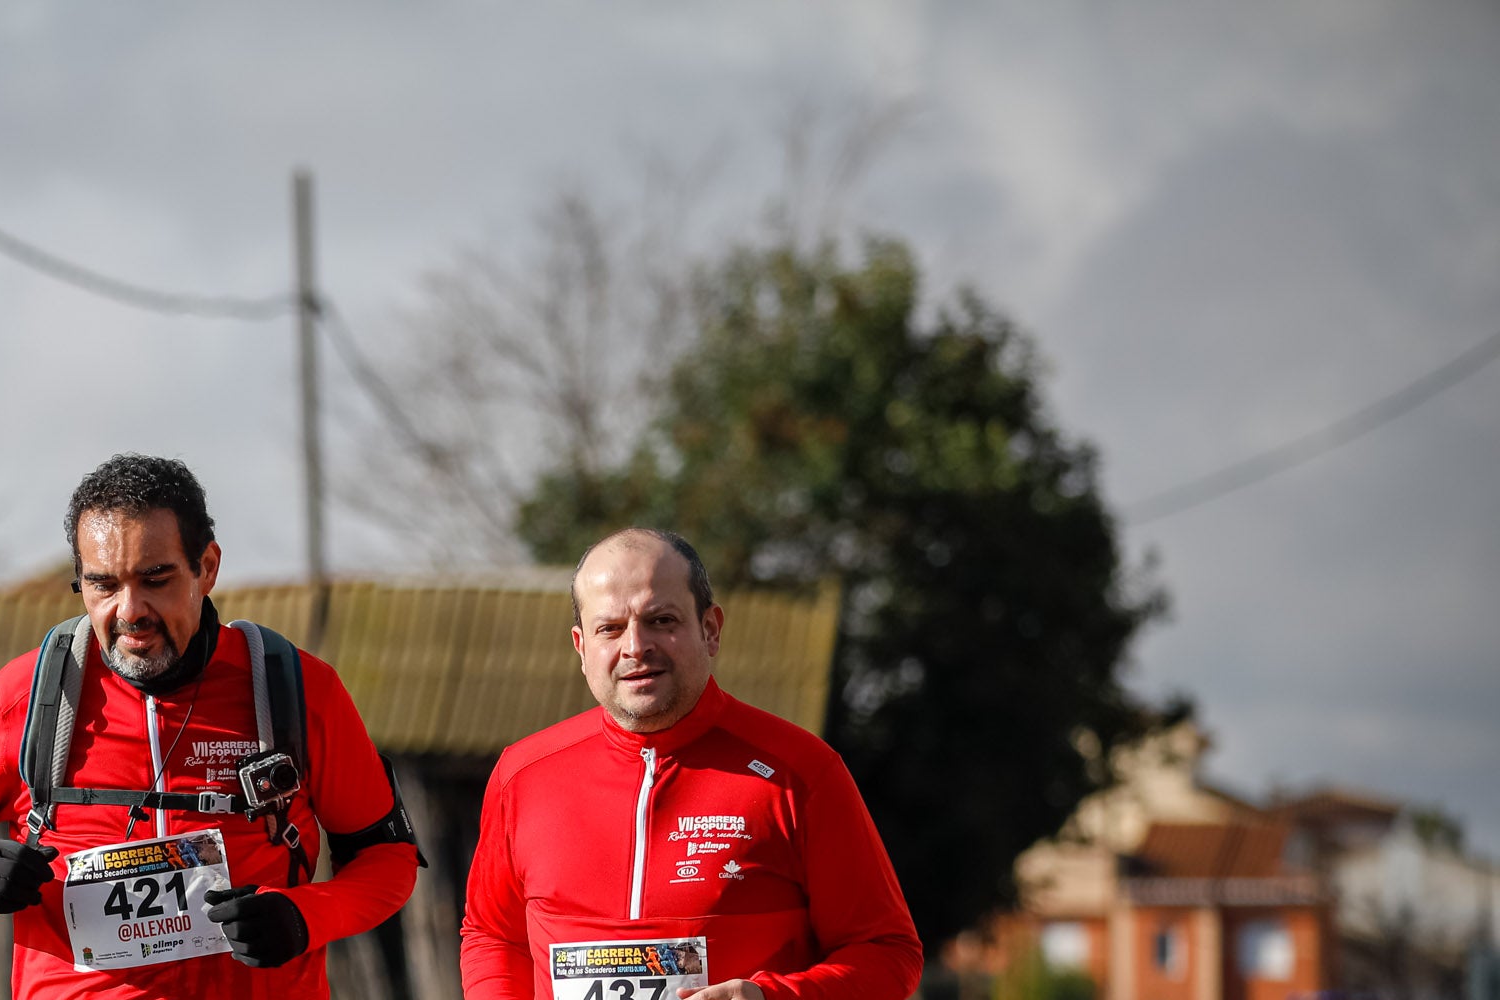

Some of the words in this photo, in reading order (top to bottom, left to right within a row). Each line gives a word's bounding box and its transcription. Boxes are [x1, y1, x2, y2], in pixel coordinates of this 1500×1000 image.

[192, 741, 207, 757] VII
[207, 756, 217, 764] de
[678, 816, 693, 832] VII
[694, 816, 745, 824] CARRERA
[694, 823, 745, 831] POPULAR
[668, 831, 688, 842] Ruta
[690, 830, 700, 839] de
[698, 842, 730, 850] olimpo
[104, 845, 163, 862] CARRERA
[106, 854, 163, 870] POPULAR
[84, 872, 92, 880] de
[93, 870, 103, 880] los
[104, 867, 138, 878] Secaderos
[680, 868, 694, 876] KIA
[104, 872, 188, 920] 421
[118, 914, 192, 942] @ALEXROD
[152, 939, 184, 948] olimpo
[576, 950, 586, 966] VII
[587, 948, 642, 958] CARRERA
[587, 958, 642, 966] POPULAR
[584, 966, 616, 974] Secaderos
